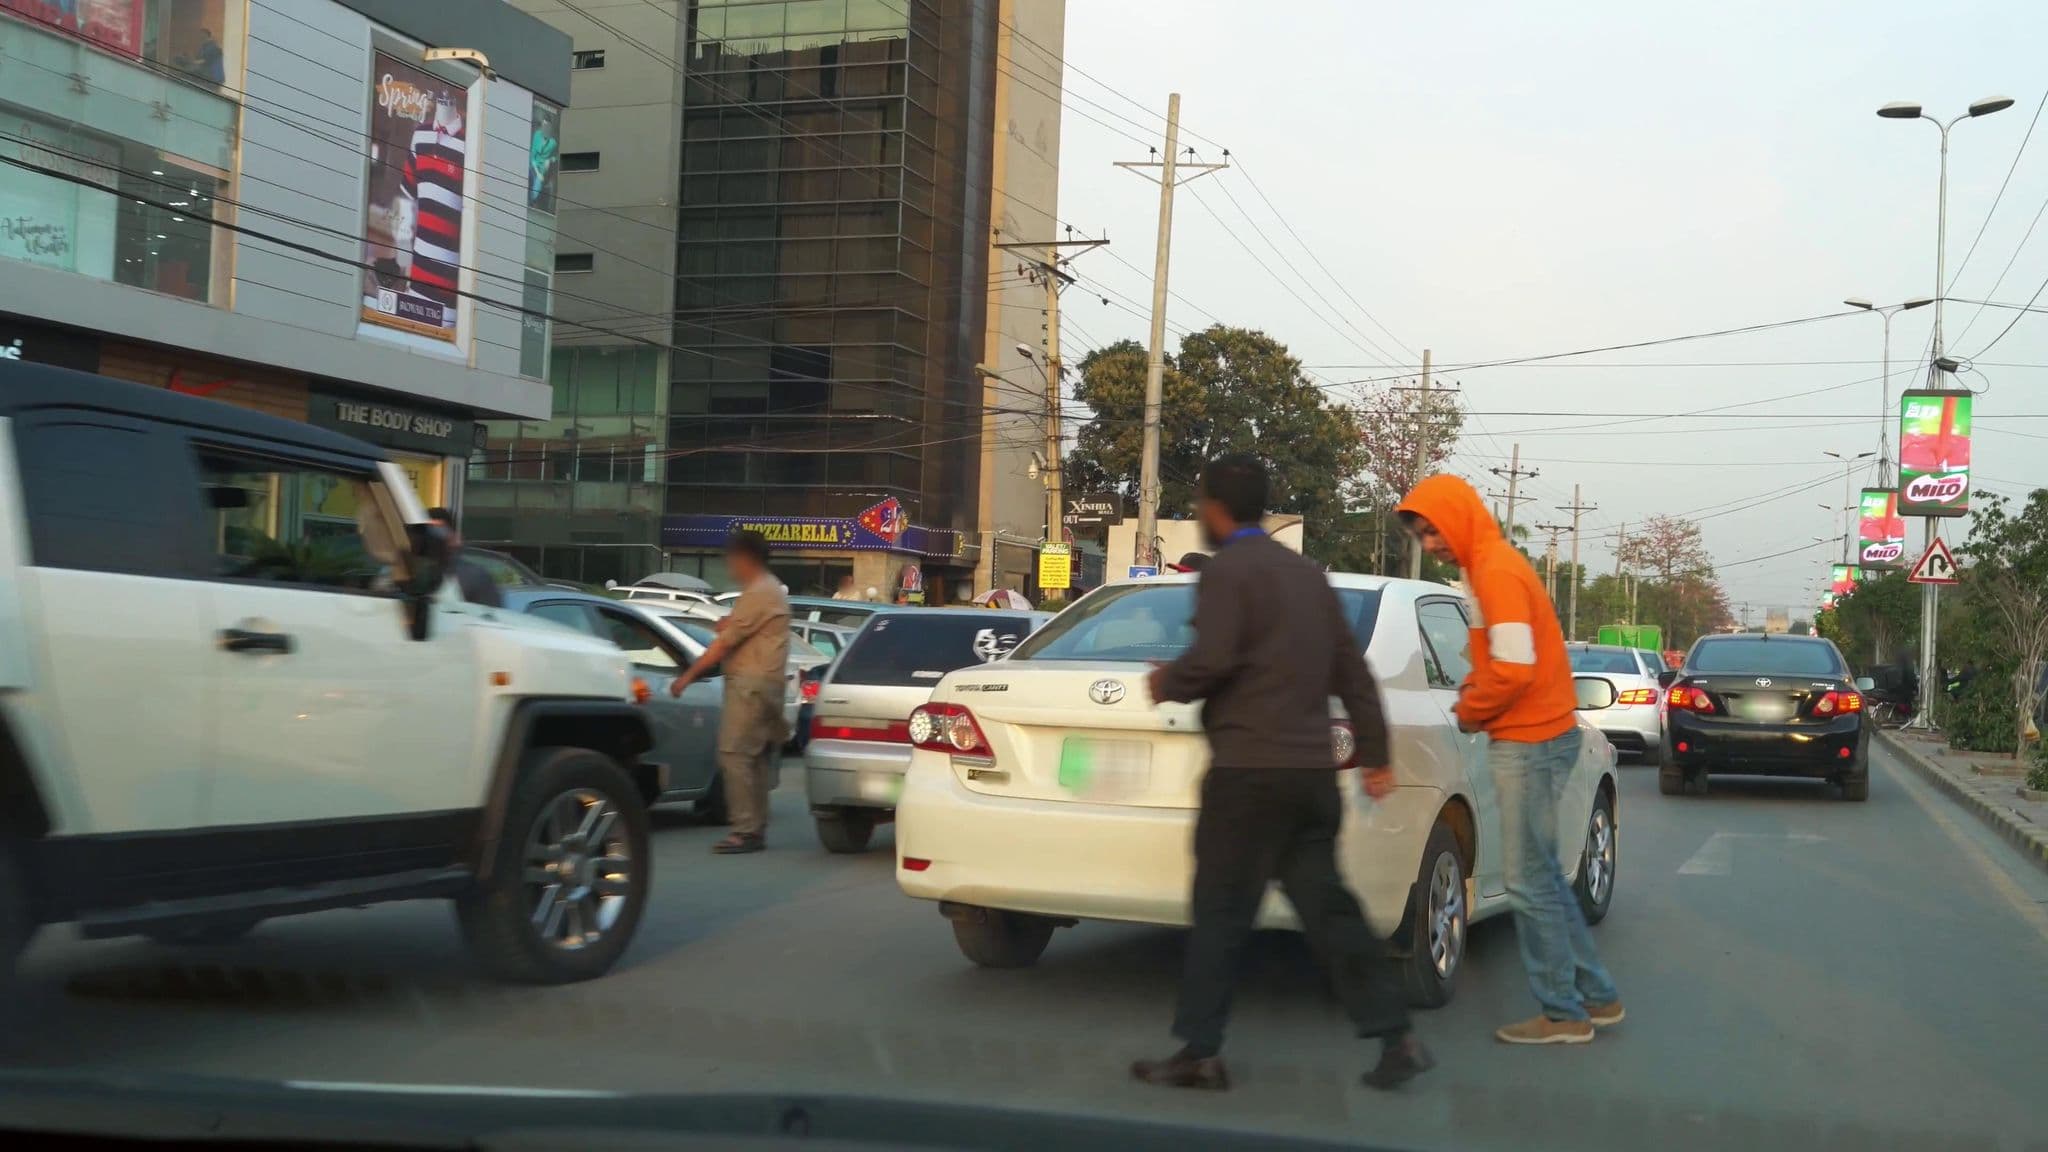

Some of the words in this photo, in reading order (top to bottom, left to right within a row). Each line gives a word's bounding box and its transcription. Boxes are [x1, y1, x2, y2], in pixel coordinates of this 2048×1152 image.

[379, 74, 428, 123] Spring
[338, 402, 369, 424] THE
[370, 408, 412, 431] BODY
[412, 416, 452, 438] SHOP
[1911, 483, 1960, 497] MILO
[1063, 515, 1079, 524] OUT
[1866, 549, 1898, 558] MILO
